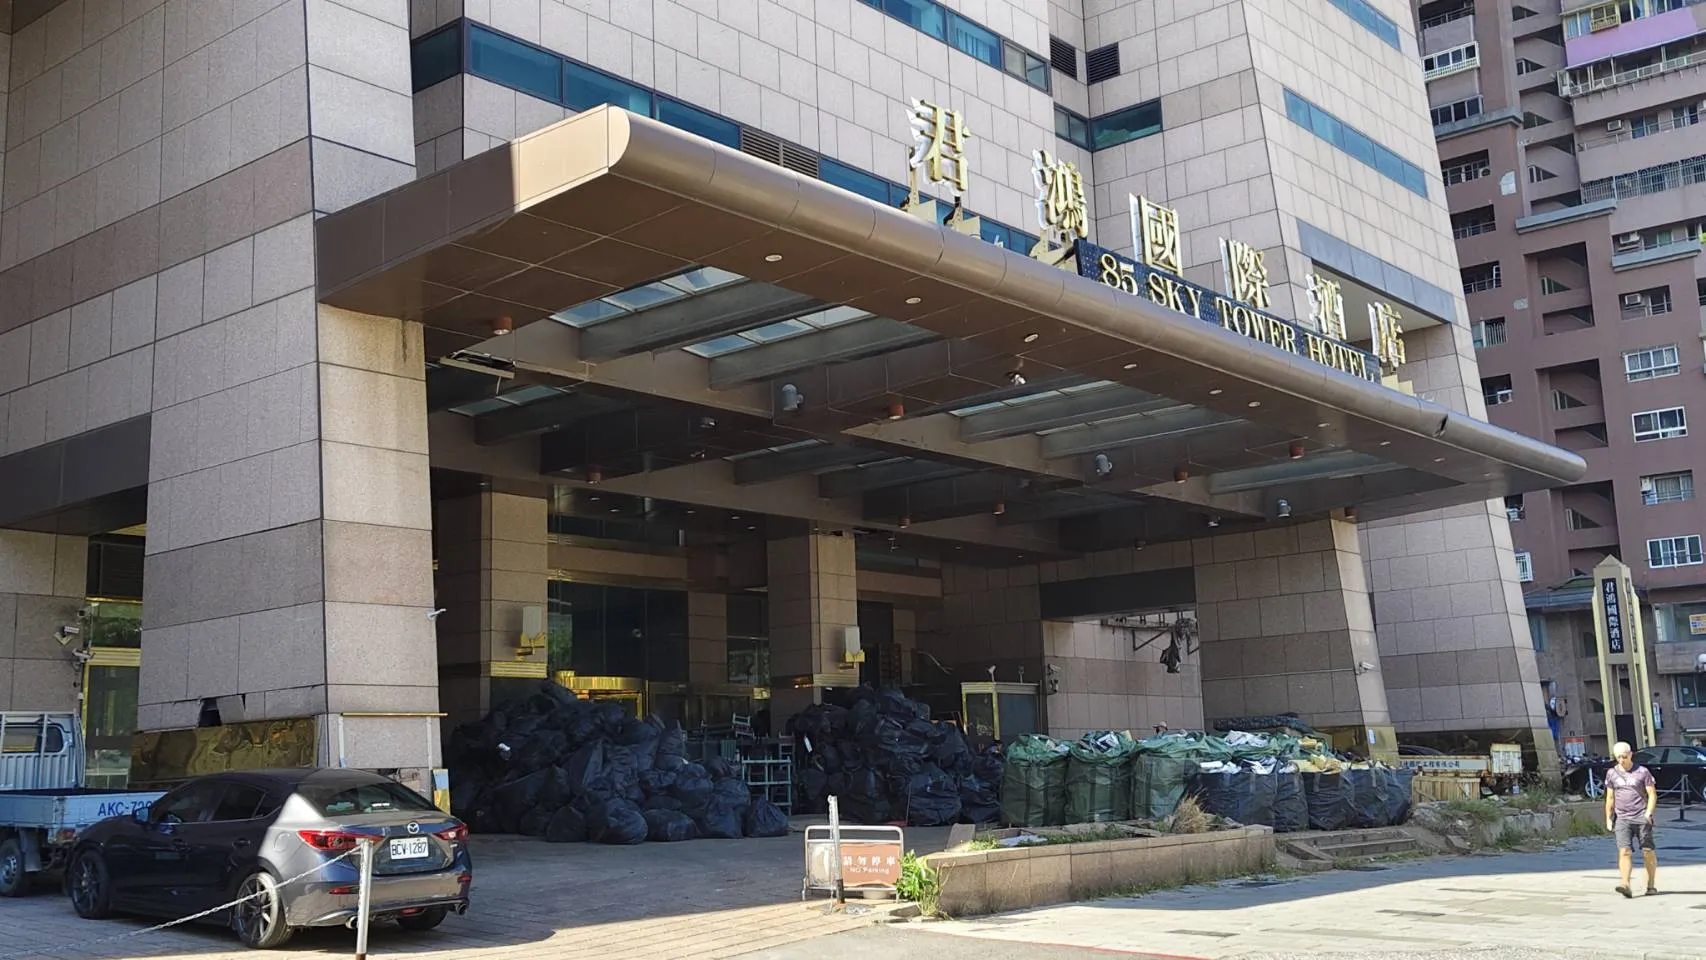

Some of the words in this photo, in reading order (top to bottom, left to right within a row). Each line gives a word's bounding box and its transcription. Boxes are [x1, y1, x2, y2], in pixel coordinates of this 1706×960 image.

[907, 96, 1406, 367] 君鴻國際酒店
[1101, 253, 1138, 296] 85
[1148, 272, 1202, 320] SKY
[1216, 296, 1297, 355] TOWER
[1304, 332, 1375, 382] HOTEL
